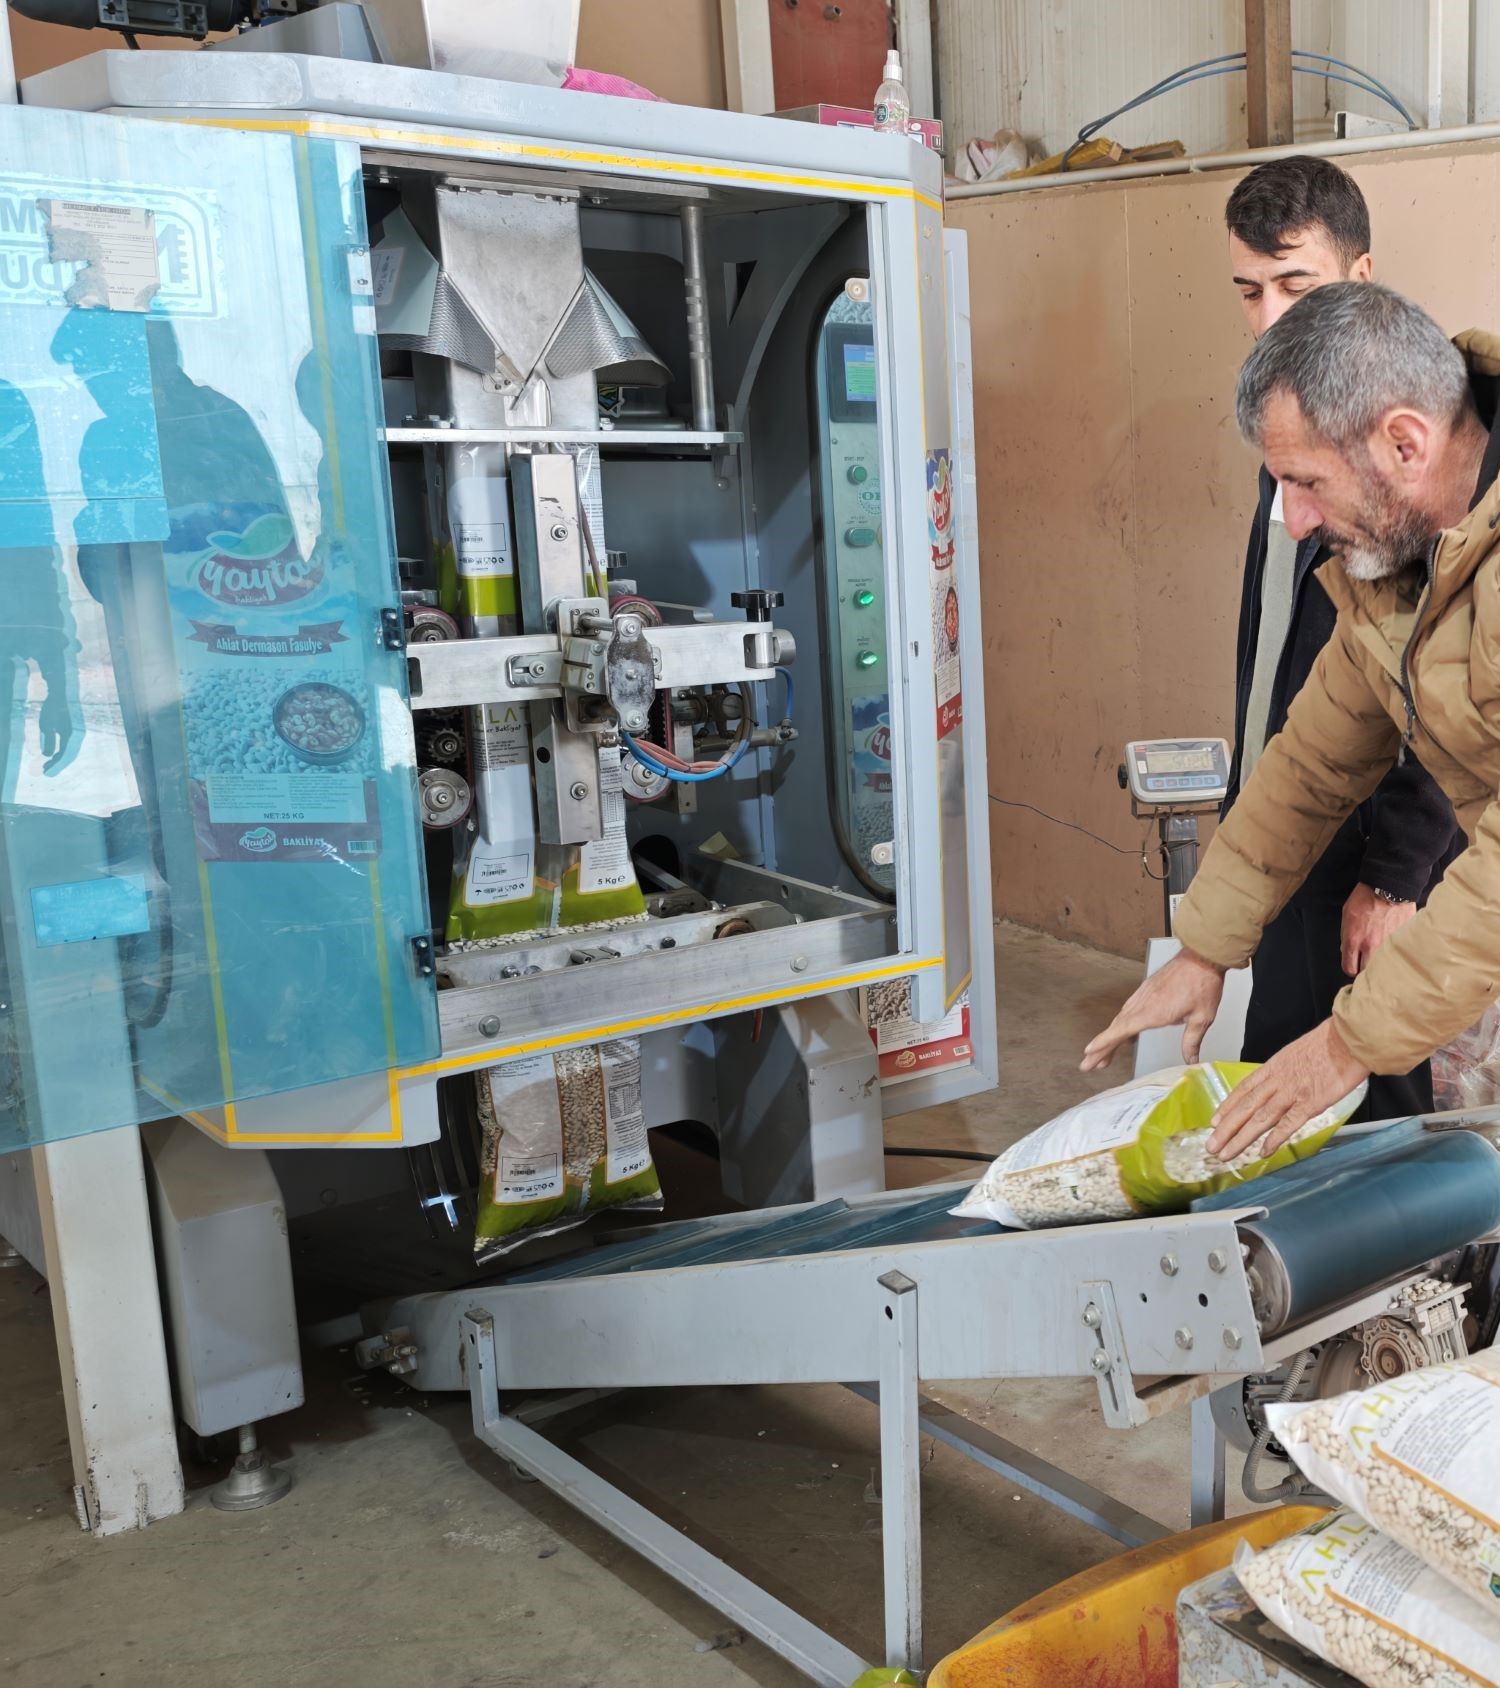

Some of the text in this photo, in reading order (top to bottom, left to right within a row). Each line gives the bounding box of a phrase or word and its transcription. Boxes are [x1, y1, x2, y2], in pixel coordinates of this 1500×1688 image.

[216, 637, 322, 654] Ahlat Dermason Fasulye
[292, 812, 305, 820] KG
[622, 1163, 639, 1174] 5 Kg
[1300, 1523, 1369, 1595] AHL
